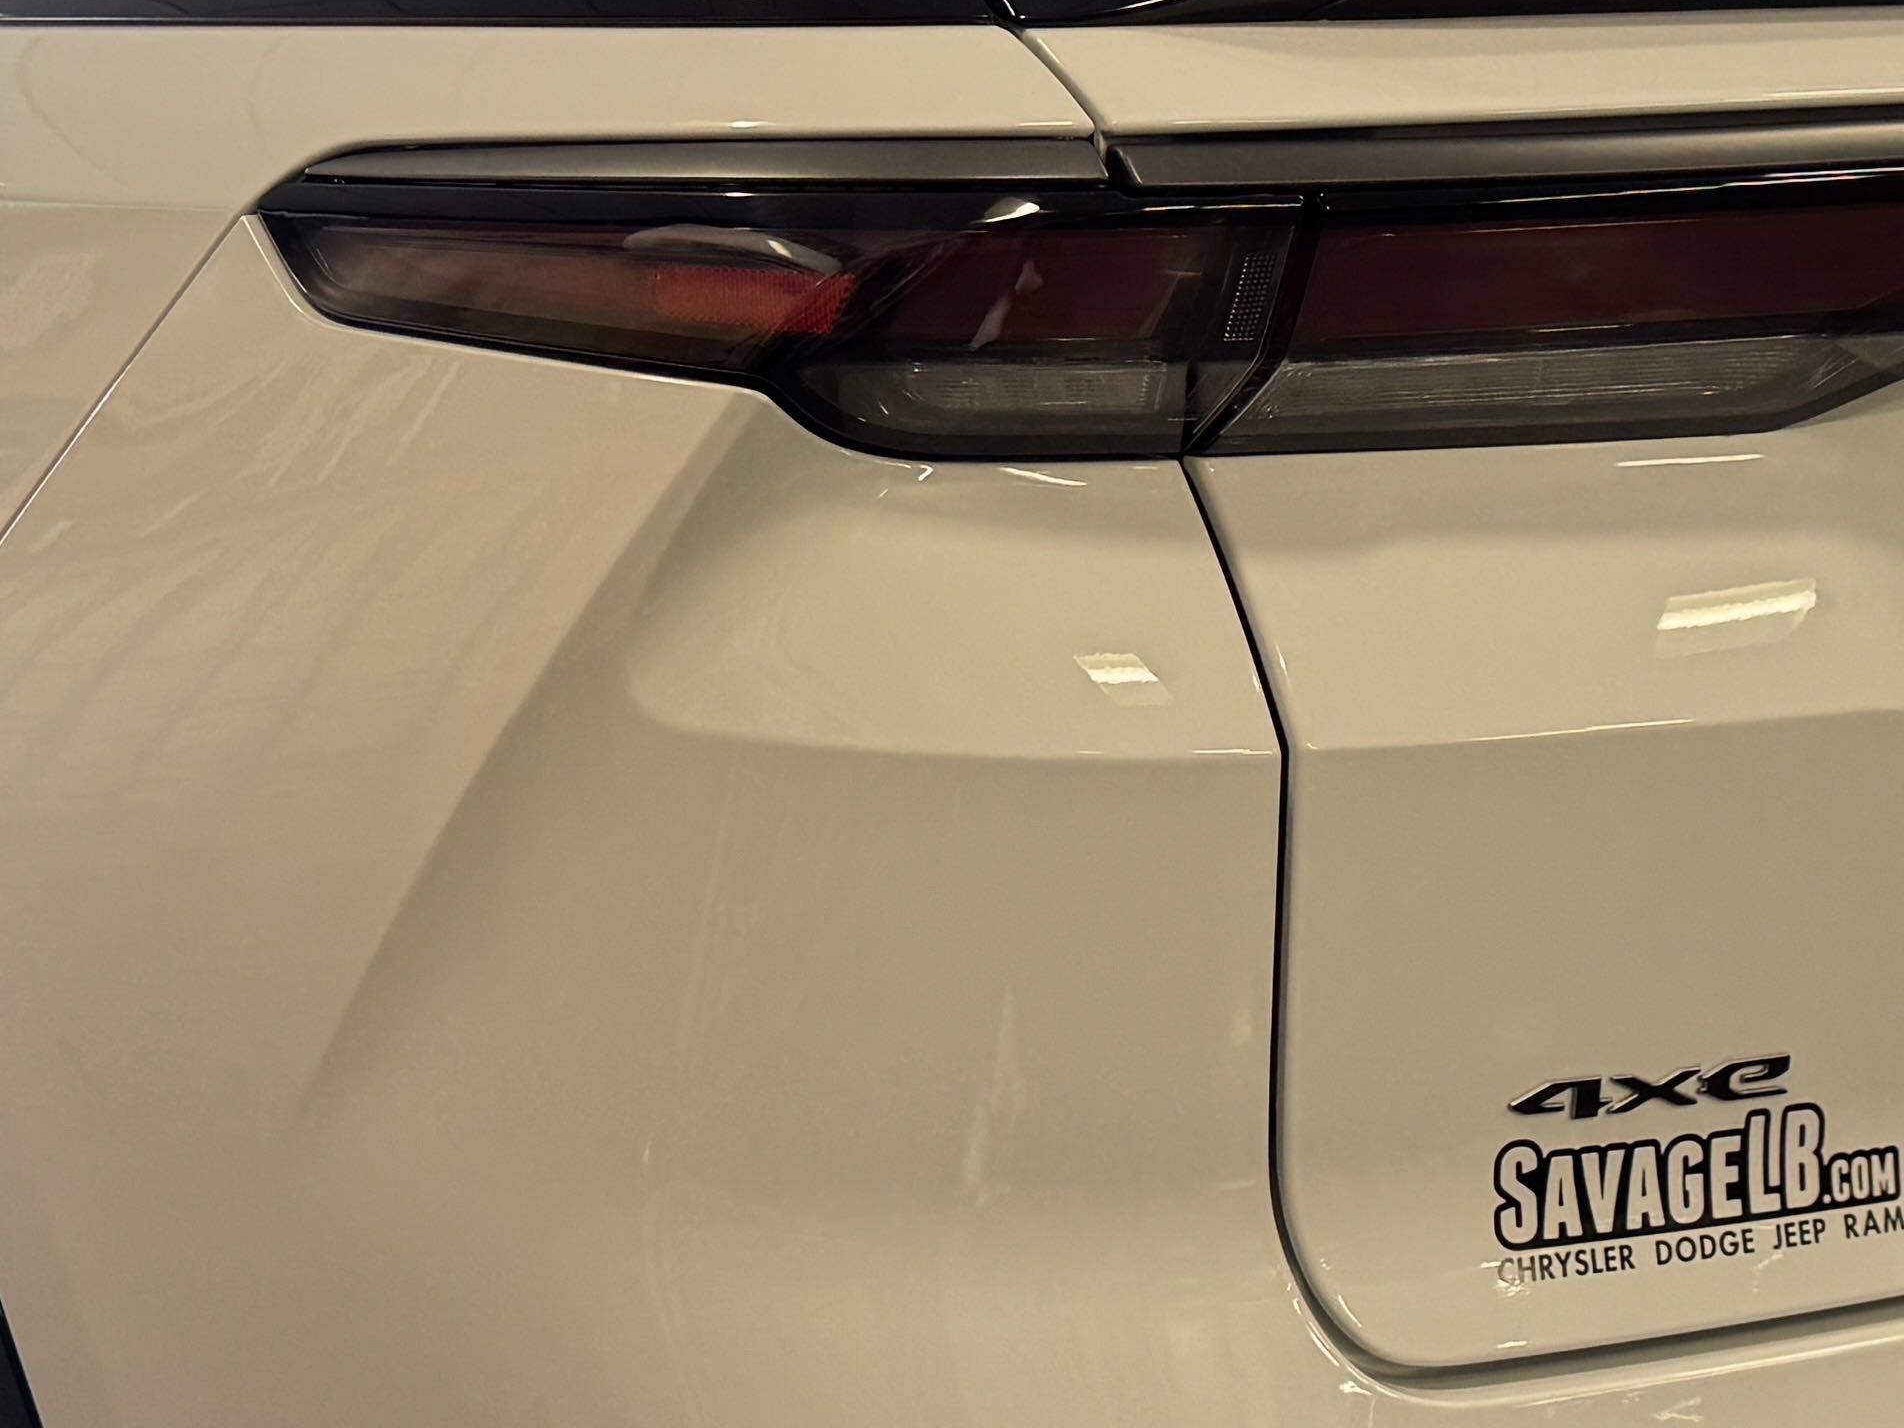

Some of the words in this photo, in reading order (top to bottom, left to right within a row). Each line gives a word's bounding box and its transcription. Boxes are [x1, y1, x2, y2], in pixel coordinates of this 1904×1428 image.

[1507, 1051, 1792, 1120] 4xe
[1497, 1244, 1636, 1284] CHRYSLER
[1655, 1228, 1756, 1266] DODGE
[1772, 1218, 1827, 1251] JEEP
